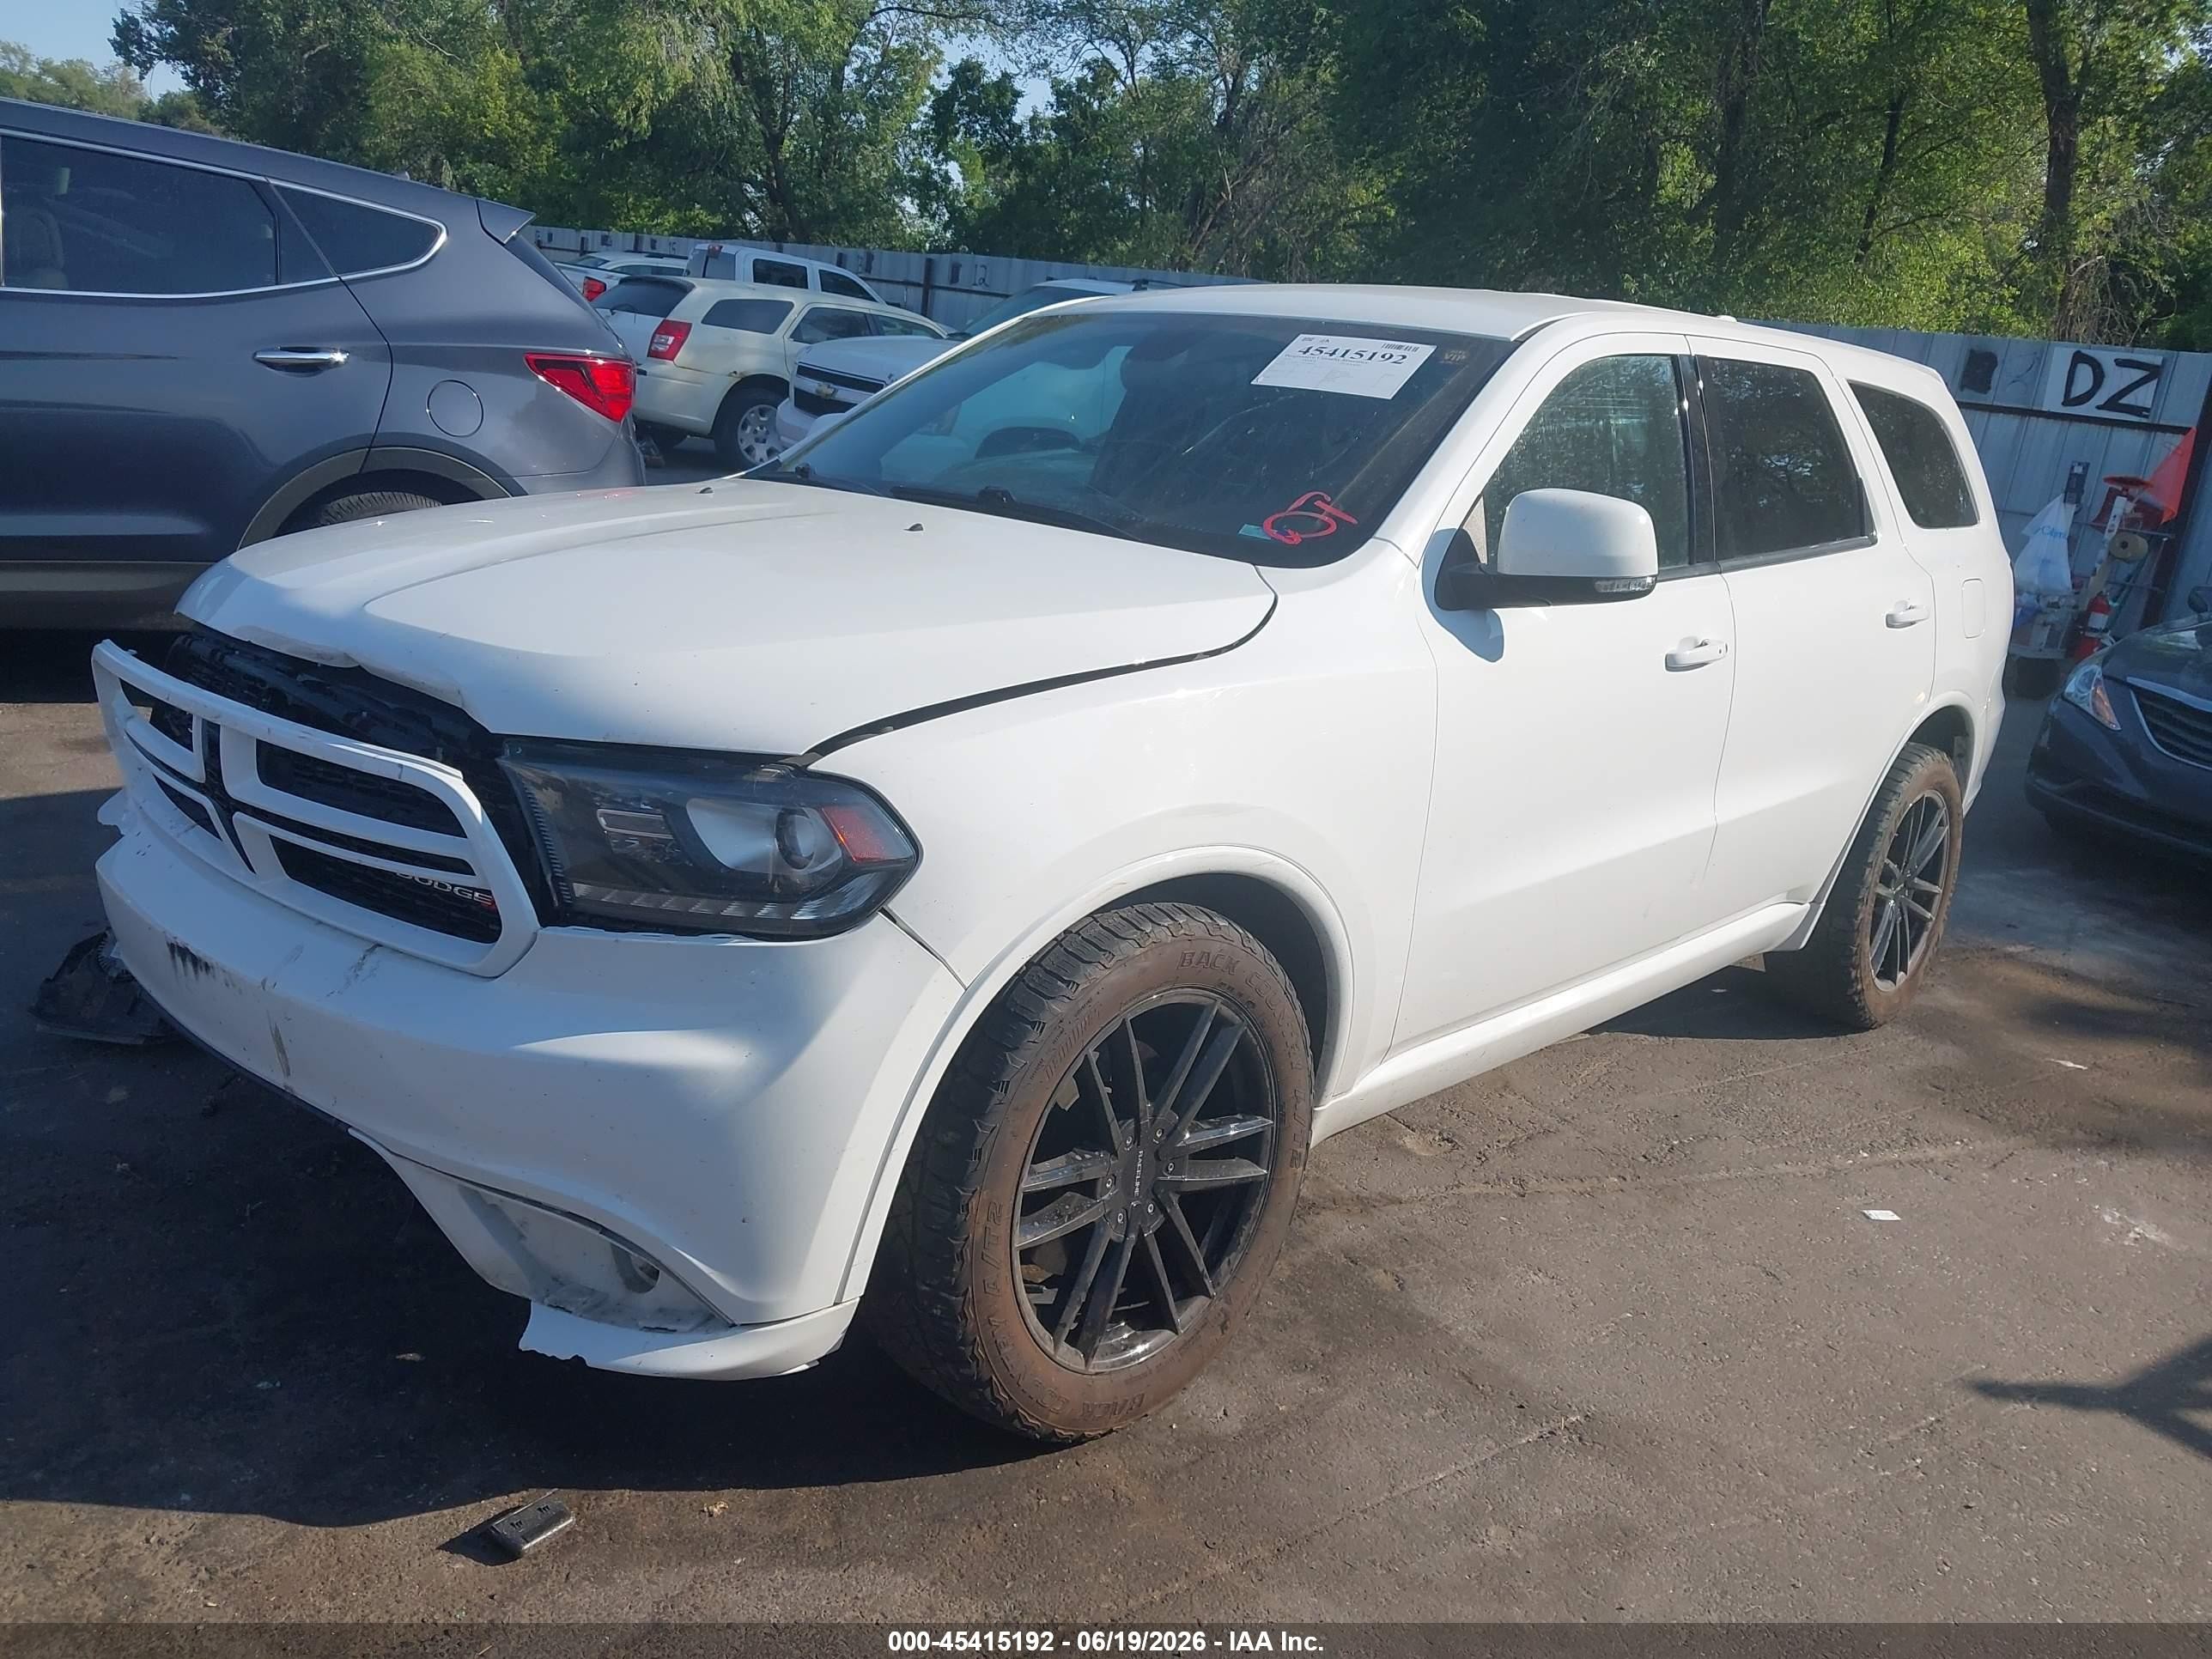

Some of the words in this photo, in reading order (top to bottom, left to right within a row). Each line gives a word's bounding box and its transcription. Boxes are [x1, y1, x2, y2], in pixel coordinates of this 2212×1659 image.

[971, 264, 990, 287] 12
[1297, 345, 1408, 365] 45415192
[1175, 949, 1241, 976] BACK
[1132, 1149, 1145, 1199] RACELINE
